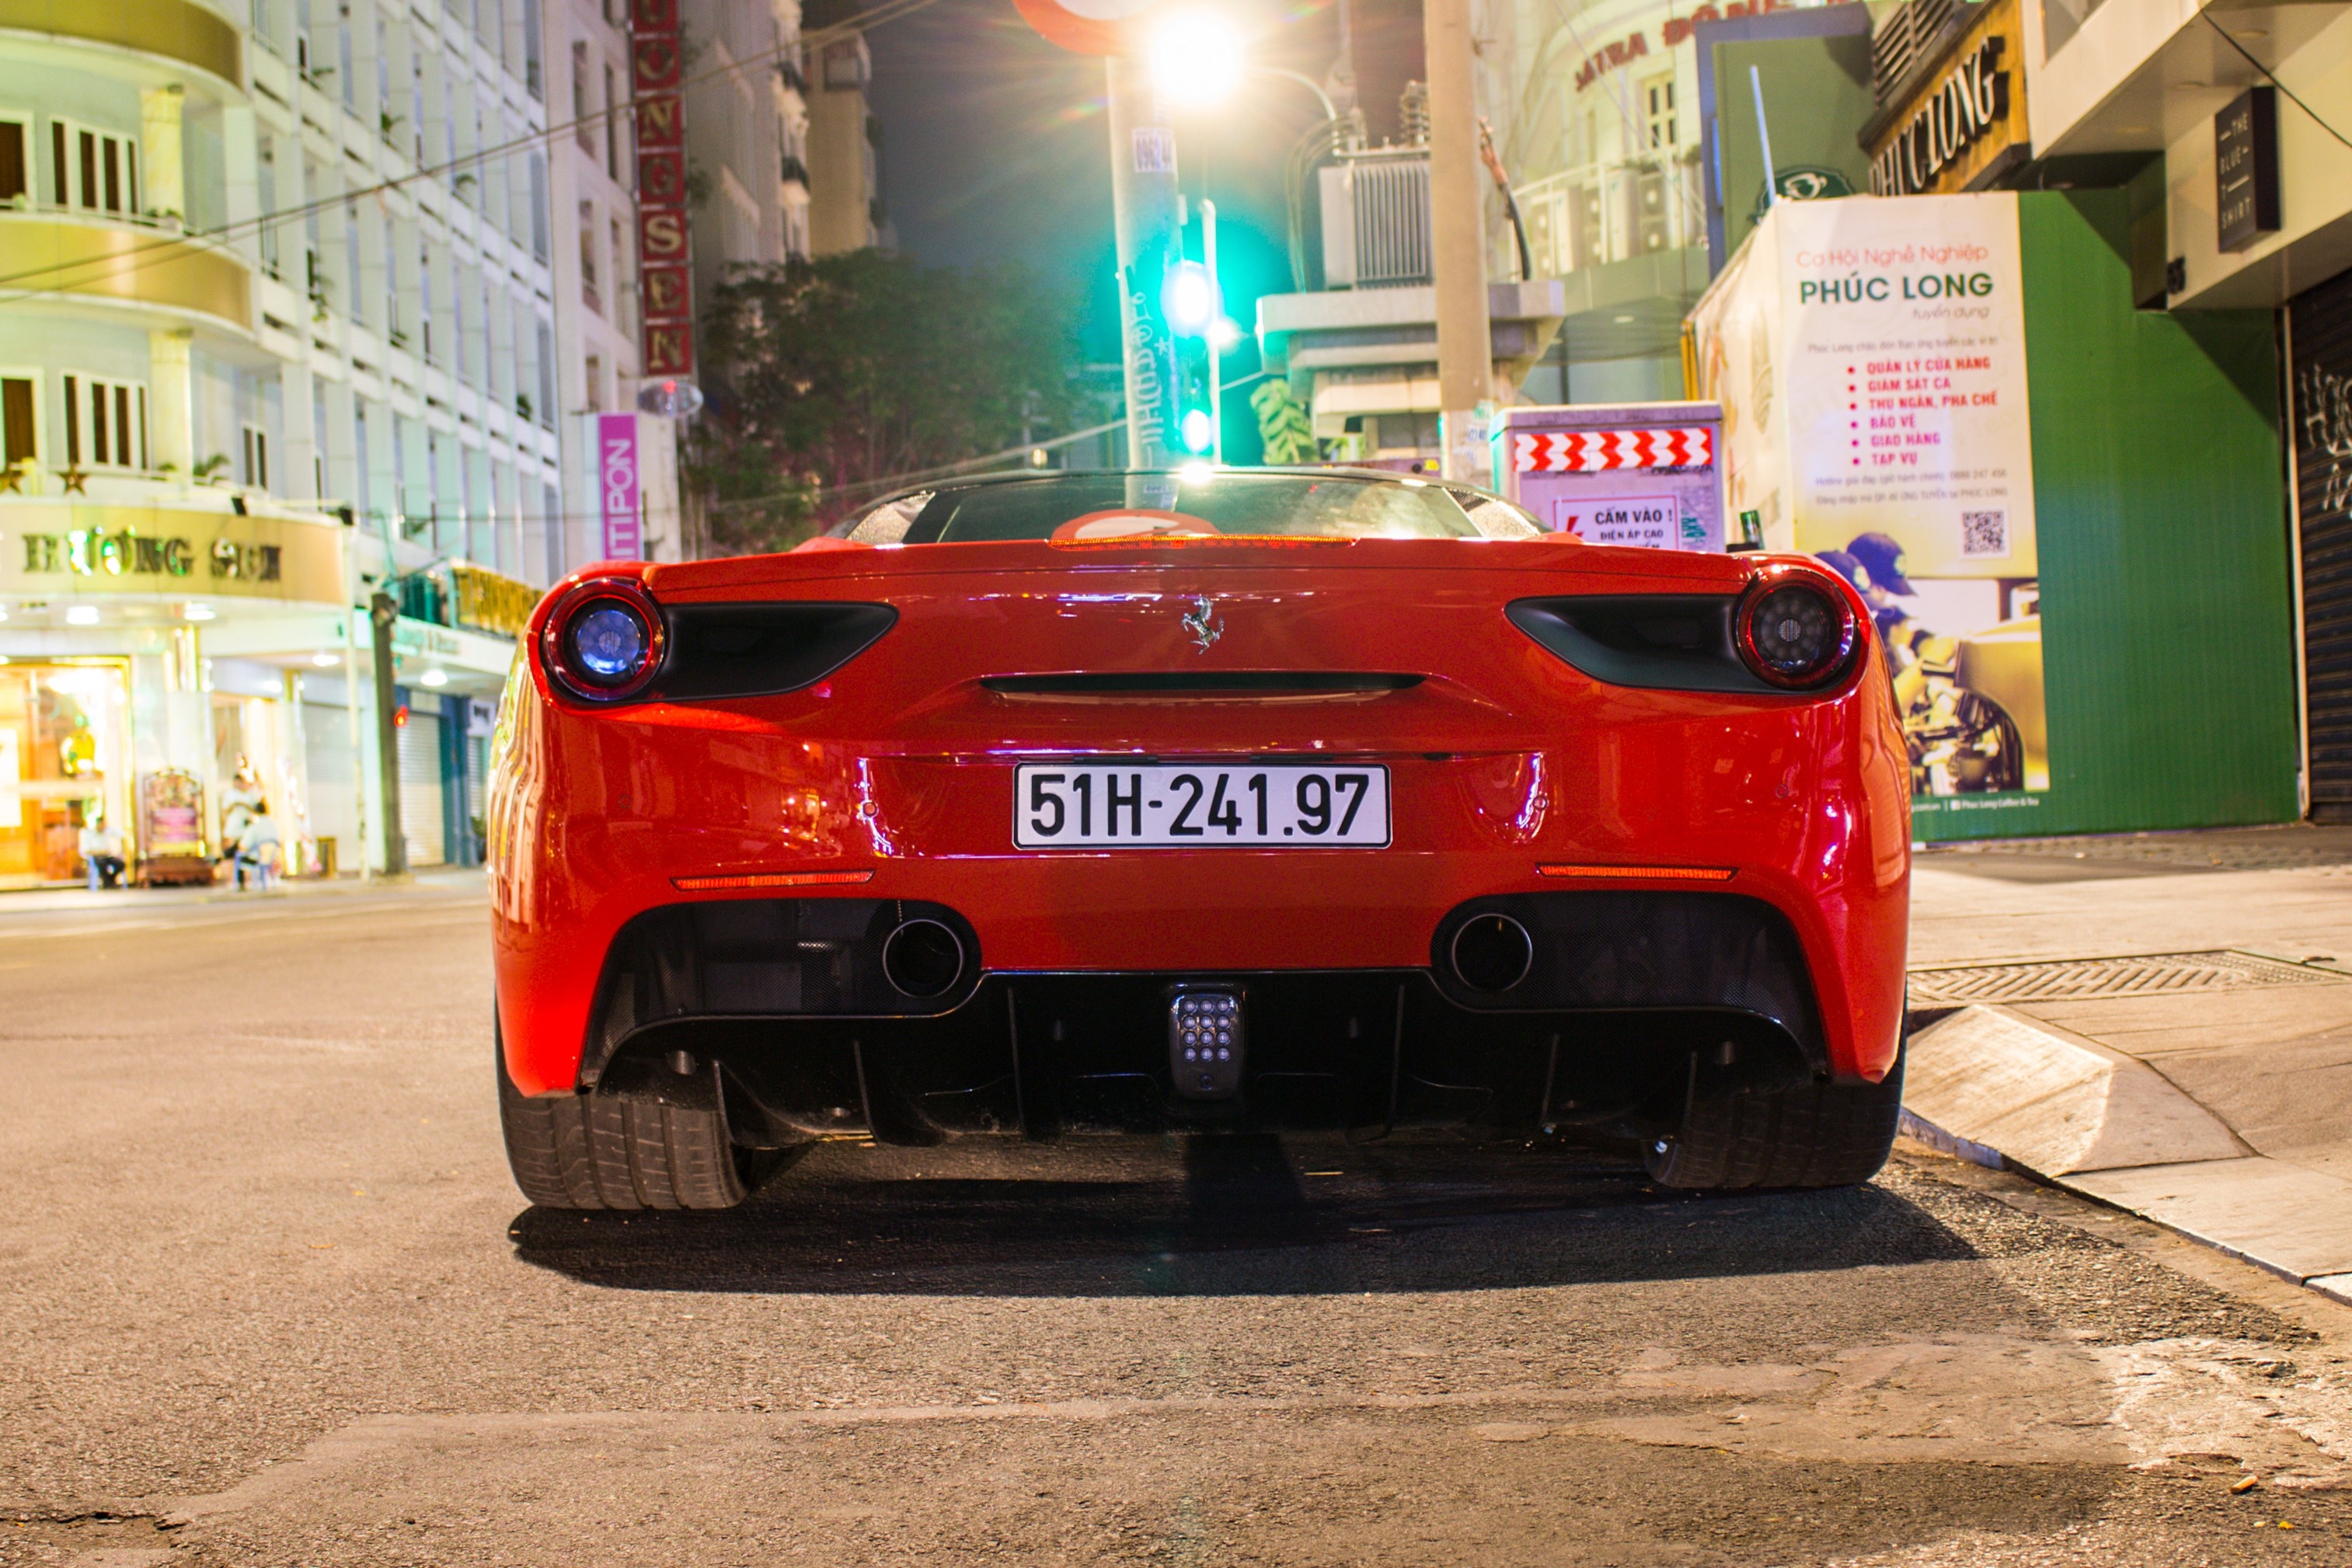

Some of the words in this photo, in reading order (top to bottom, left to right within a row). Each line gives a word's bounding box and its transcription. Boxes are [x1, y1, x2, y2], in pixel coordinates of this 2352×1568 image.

[1925, 35, 1995, 176] LONG
[1800, 270, 1890, 304] PHÚC
[1903, 273, 1994, 299] LONG
[606, 439, 636, 560] ITIPON
[1595, 507, 1628, 524] CẤM
[1633, 507, 1663, 522] VÀO
[1030, 774, 1369, 837] 51H-241.97
